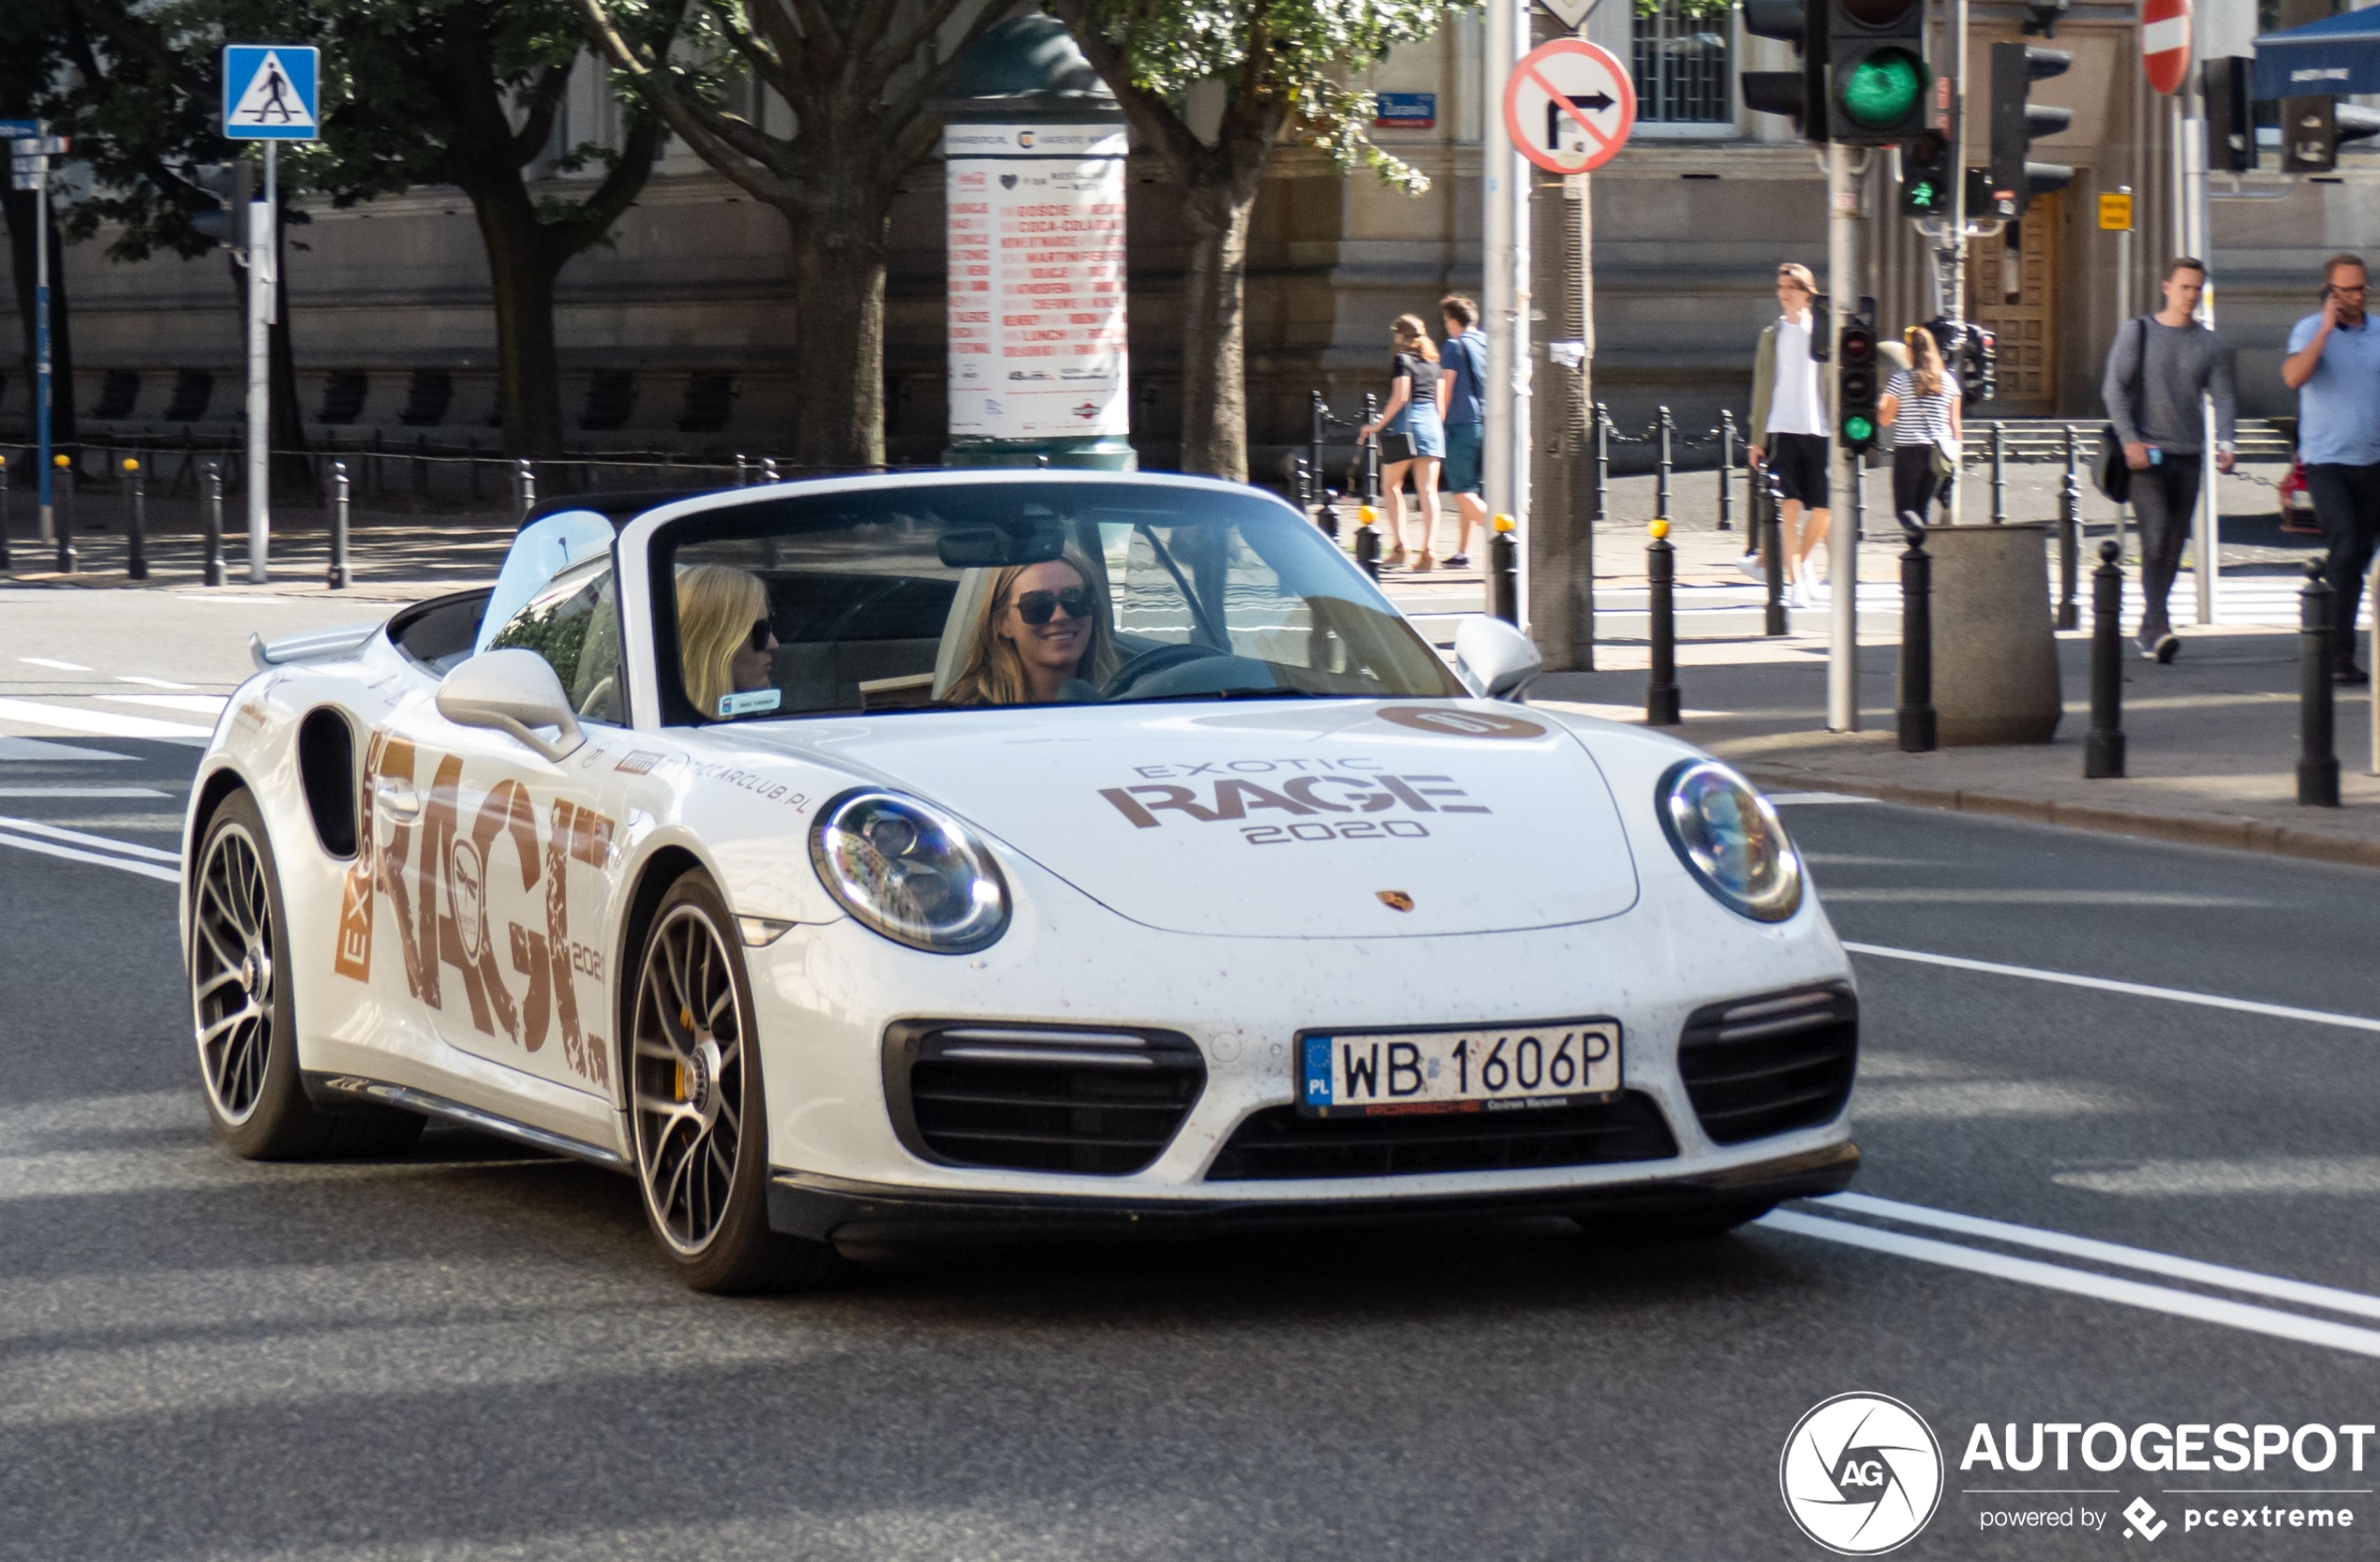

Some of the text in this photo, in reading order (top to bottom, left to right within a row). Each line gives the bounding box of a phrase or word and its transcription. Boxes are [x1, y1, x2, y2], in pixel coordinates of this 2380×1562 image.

[1134, 757, 1384, 779] EXOTIC
[1097, 775, 1493, 829] RAGE
[343, 733, 379, 964] EXOTIC
[1240, 820, 1431, 845] 2020
[1343, 1032, 1611, 1098] WB 1606P
[1309, 1079, 1330, 1095] PL
